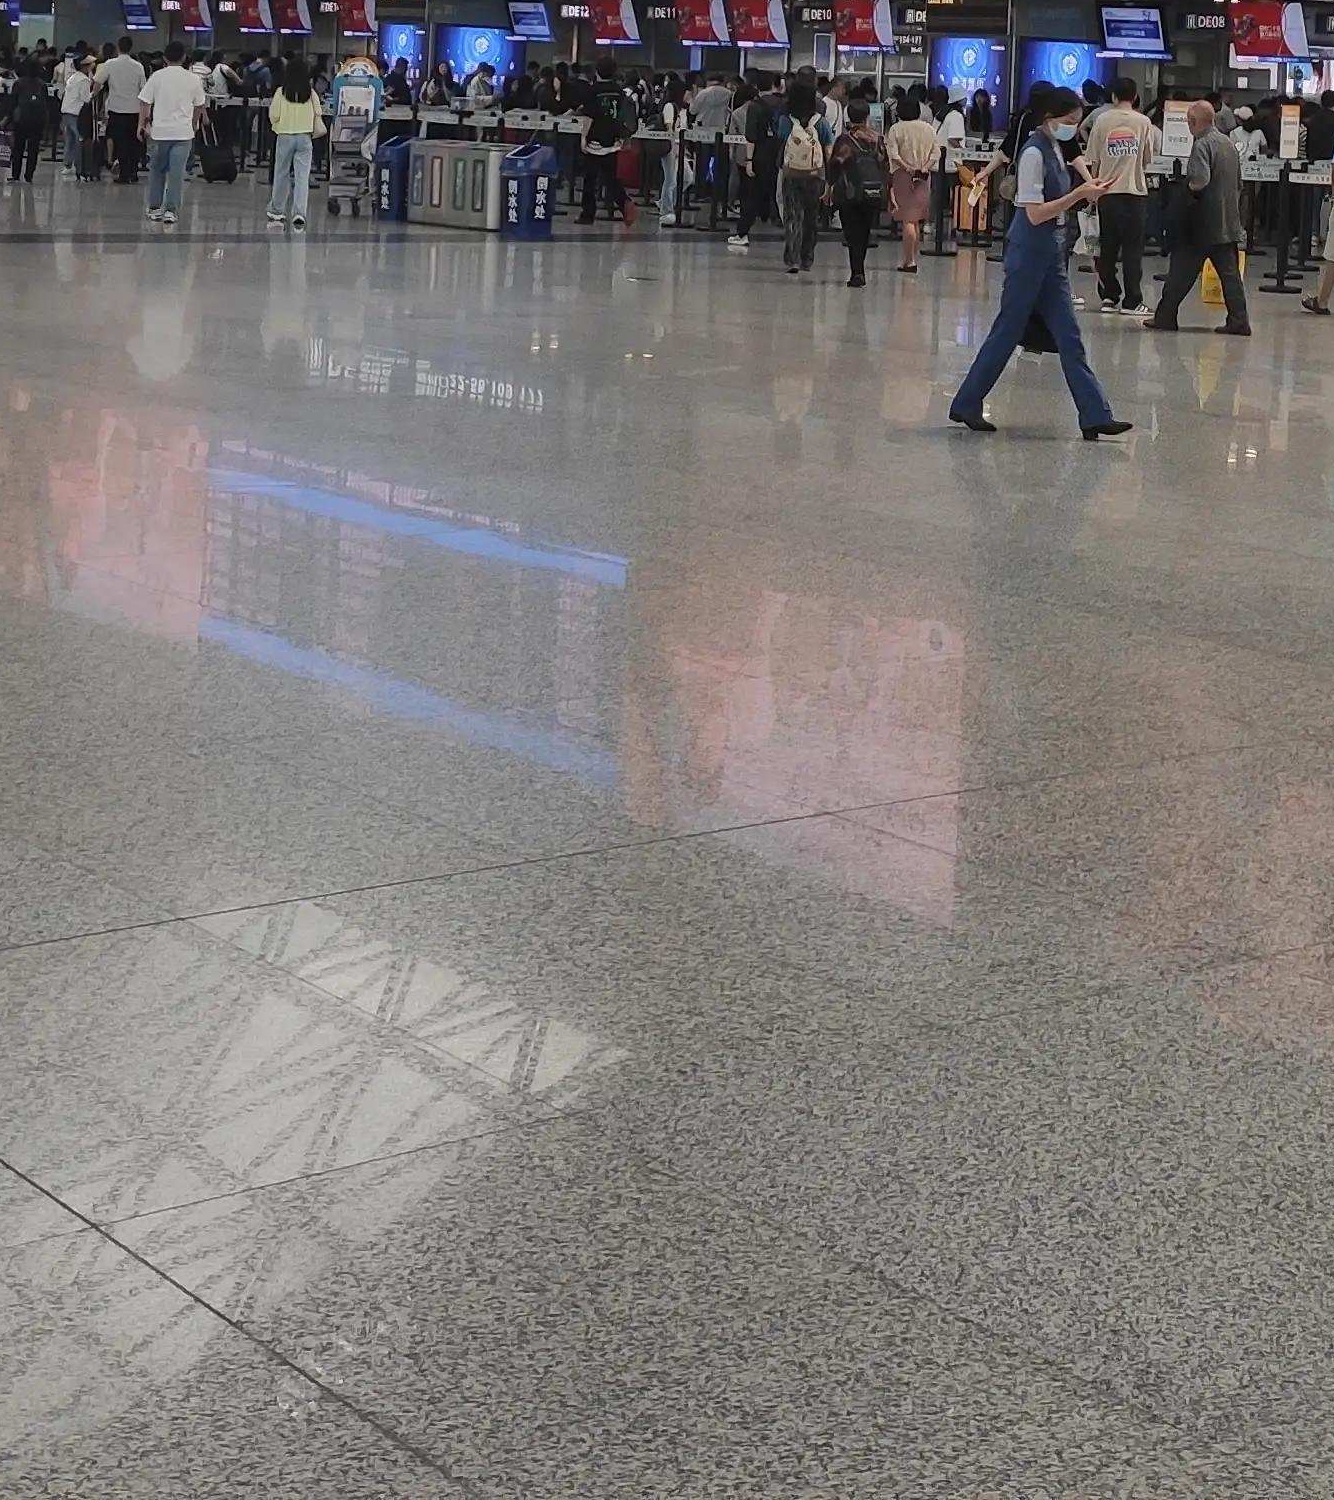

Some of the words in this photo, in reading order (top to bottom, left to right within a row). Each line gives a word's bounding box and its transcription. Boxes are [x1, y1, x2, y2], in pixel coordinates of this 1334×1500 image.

[654, 7, 677, 19] DE11
[811, 8, 833, 20] DE10
[1198, 15, 1226, 28] DE08
